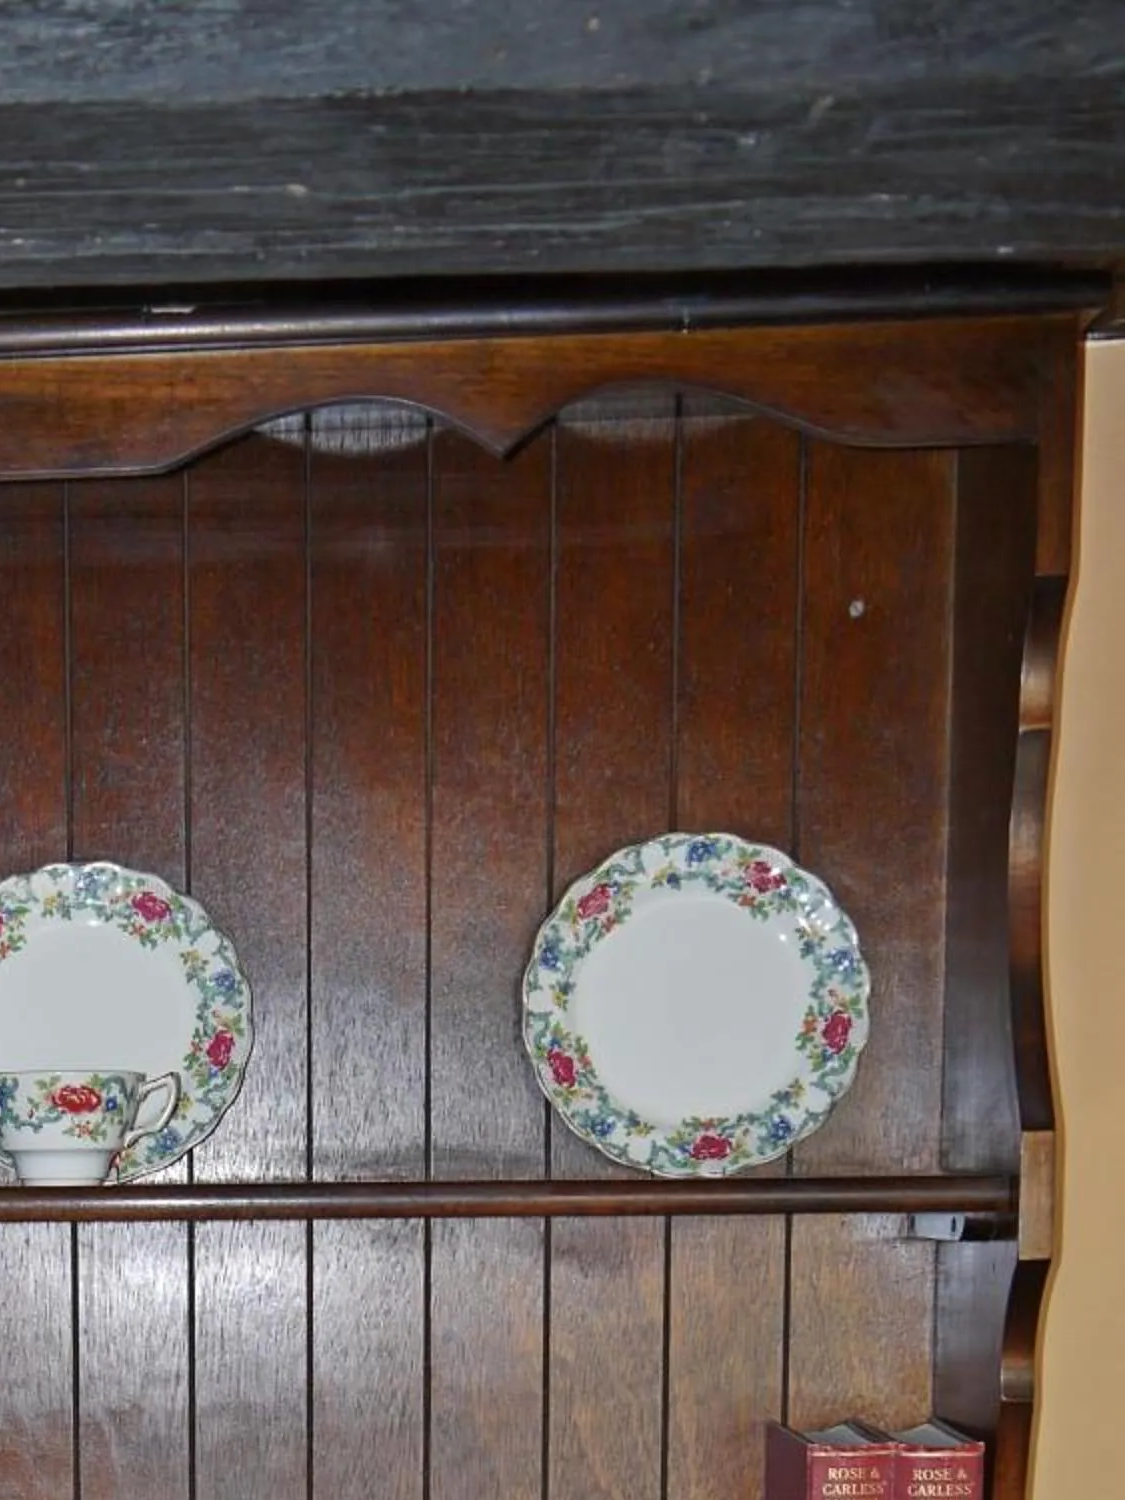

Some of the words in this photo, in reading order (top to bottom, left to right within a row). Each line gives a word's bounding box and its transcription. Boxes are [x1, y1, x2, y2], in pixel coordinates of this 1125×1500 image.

[828, 1467, 865, 1480] ROSE
[870, 1467, 881, 1479] &
[913, 1469, 952, 1481] ROSE
